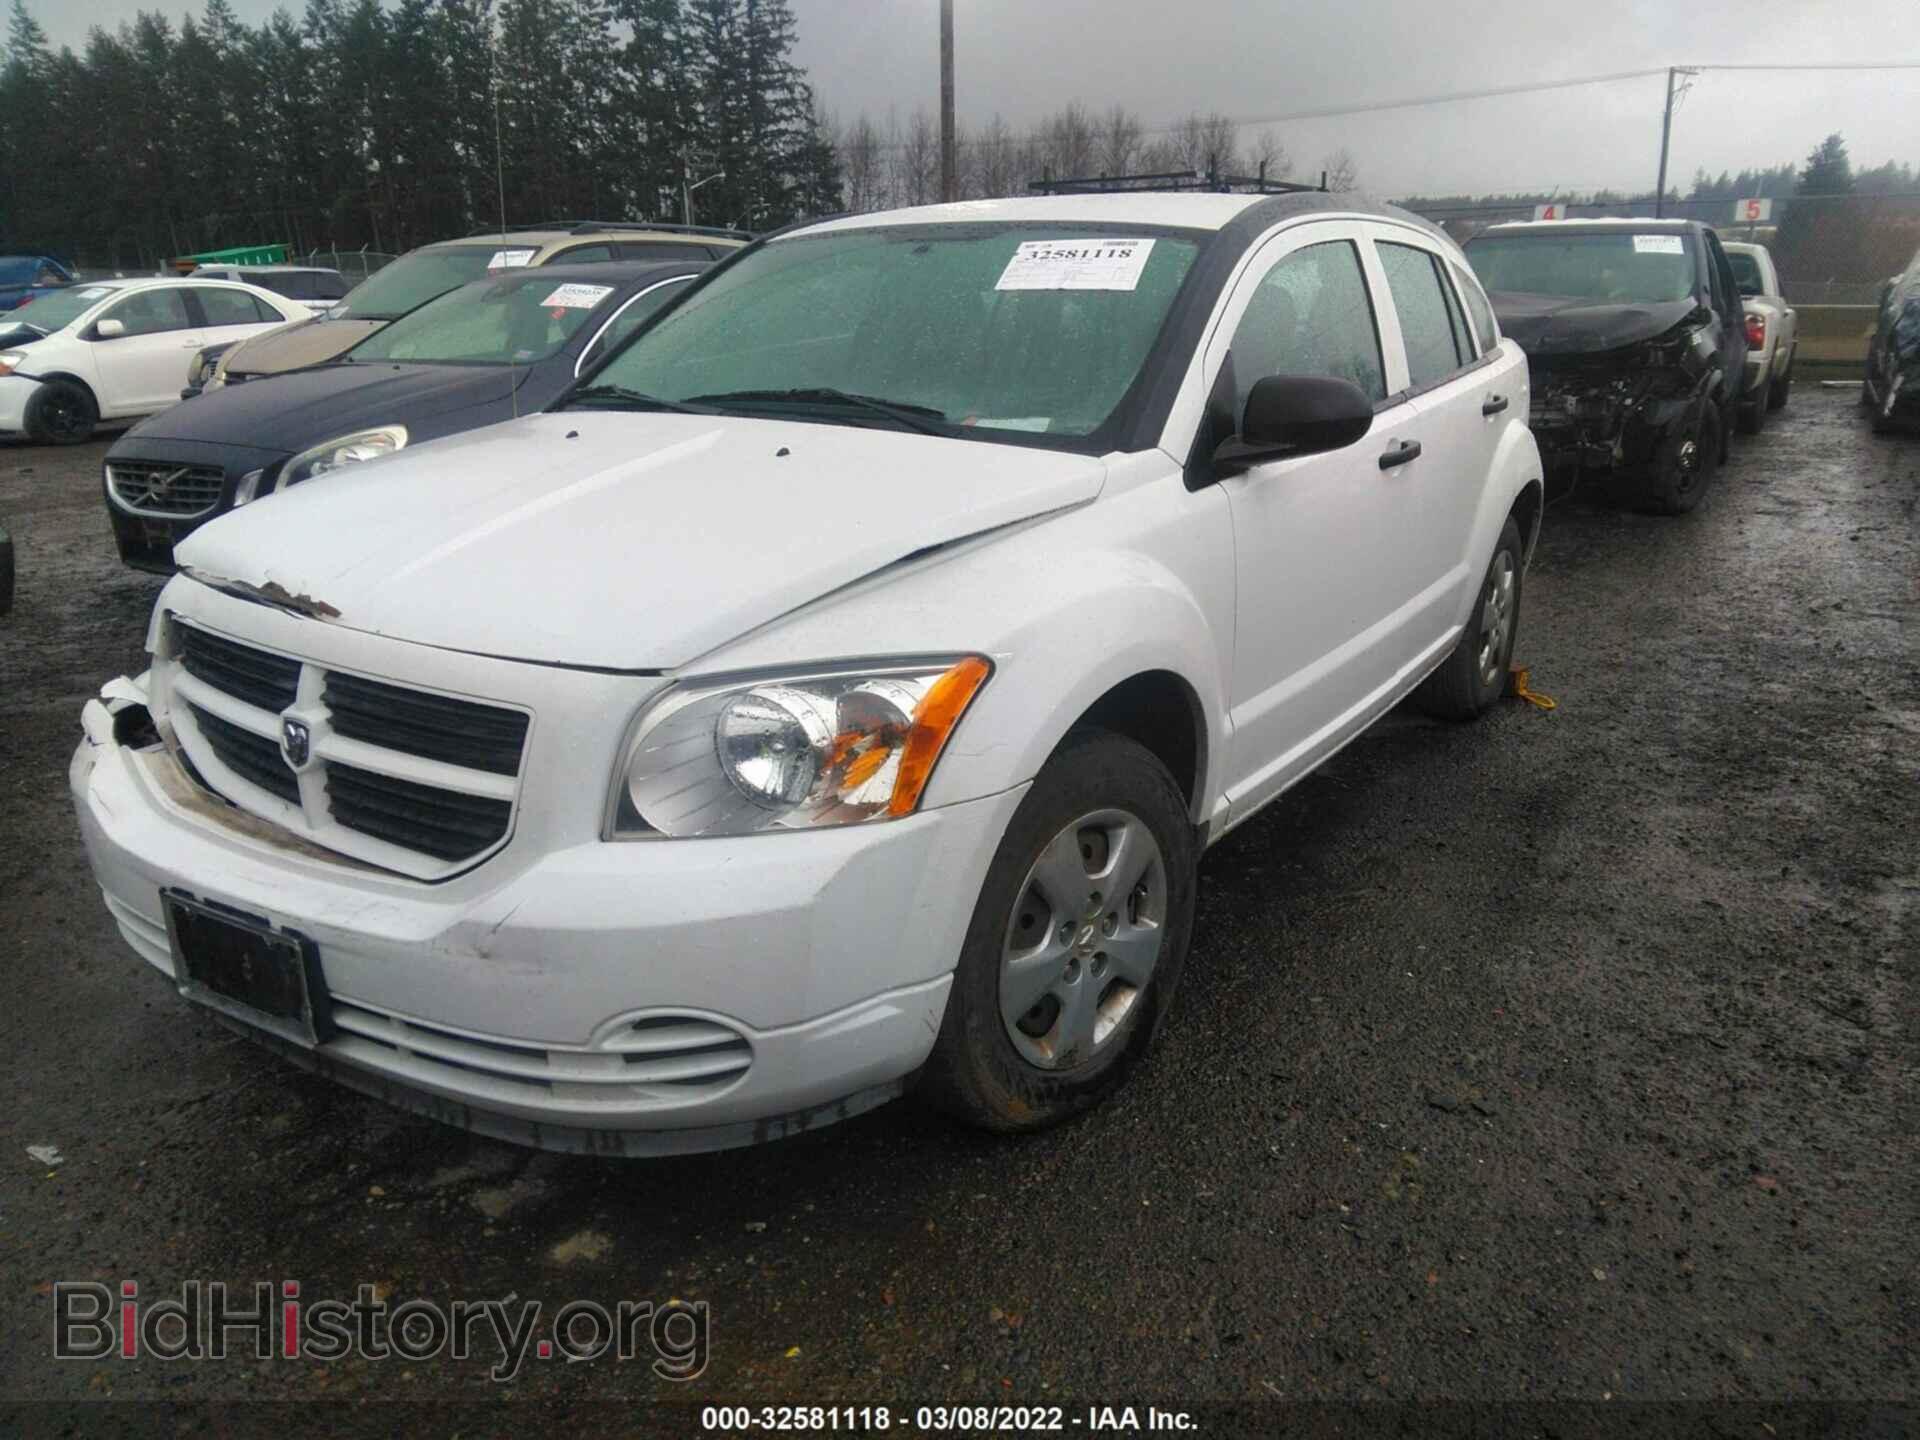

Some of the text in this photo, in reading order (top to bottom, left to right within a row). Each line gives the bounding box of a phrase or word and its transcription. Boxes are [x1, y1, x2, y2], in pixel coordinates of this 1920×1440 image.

[1542, 205, 1556, 221] 4
[1745, 199, 1761, 220] 5
[1025, 248, 1133, 261] 32581118
